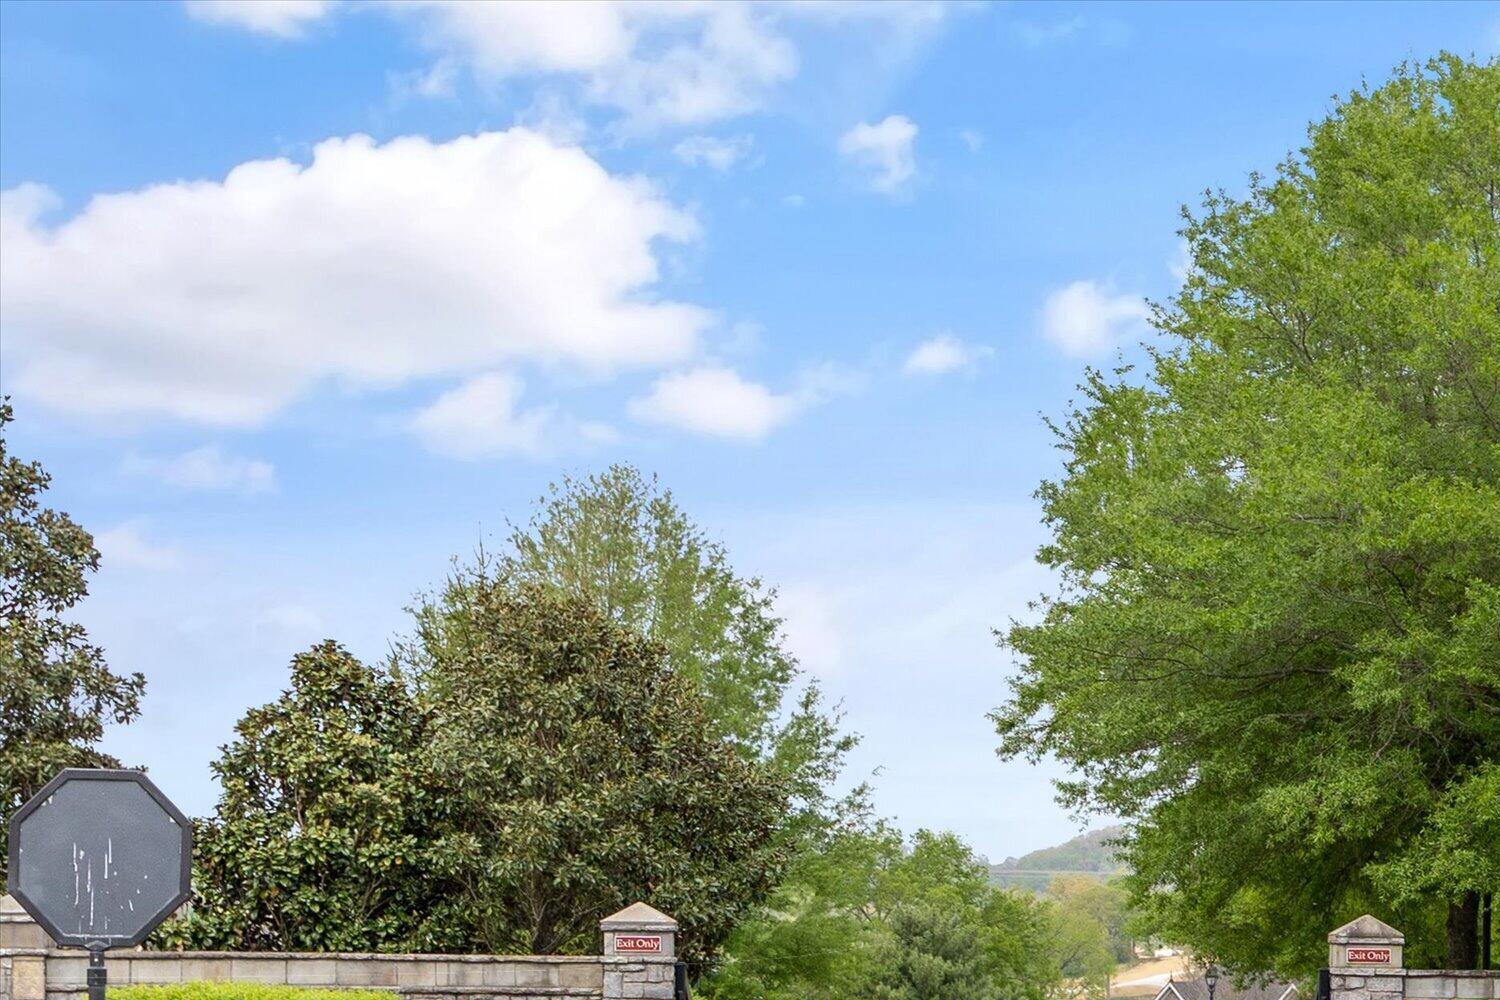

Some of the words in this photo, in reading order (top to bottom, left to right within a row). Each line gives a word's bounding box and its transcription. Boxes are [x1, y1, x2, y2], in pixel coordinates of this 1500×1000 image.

[617, 939, 634, 948] Exit
[636, 939, 660, 950] Only
[1348, 951, 1366, 960] Exit
[1367, 951, 1389, 962] Only
